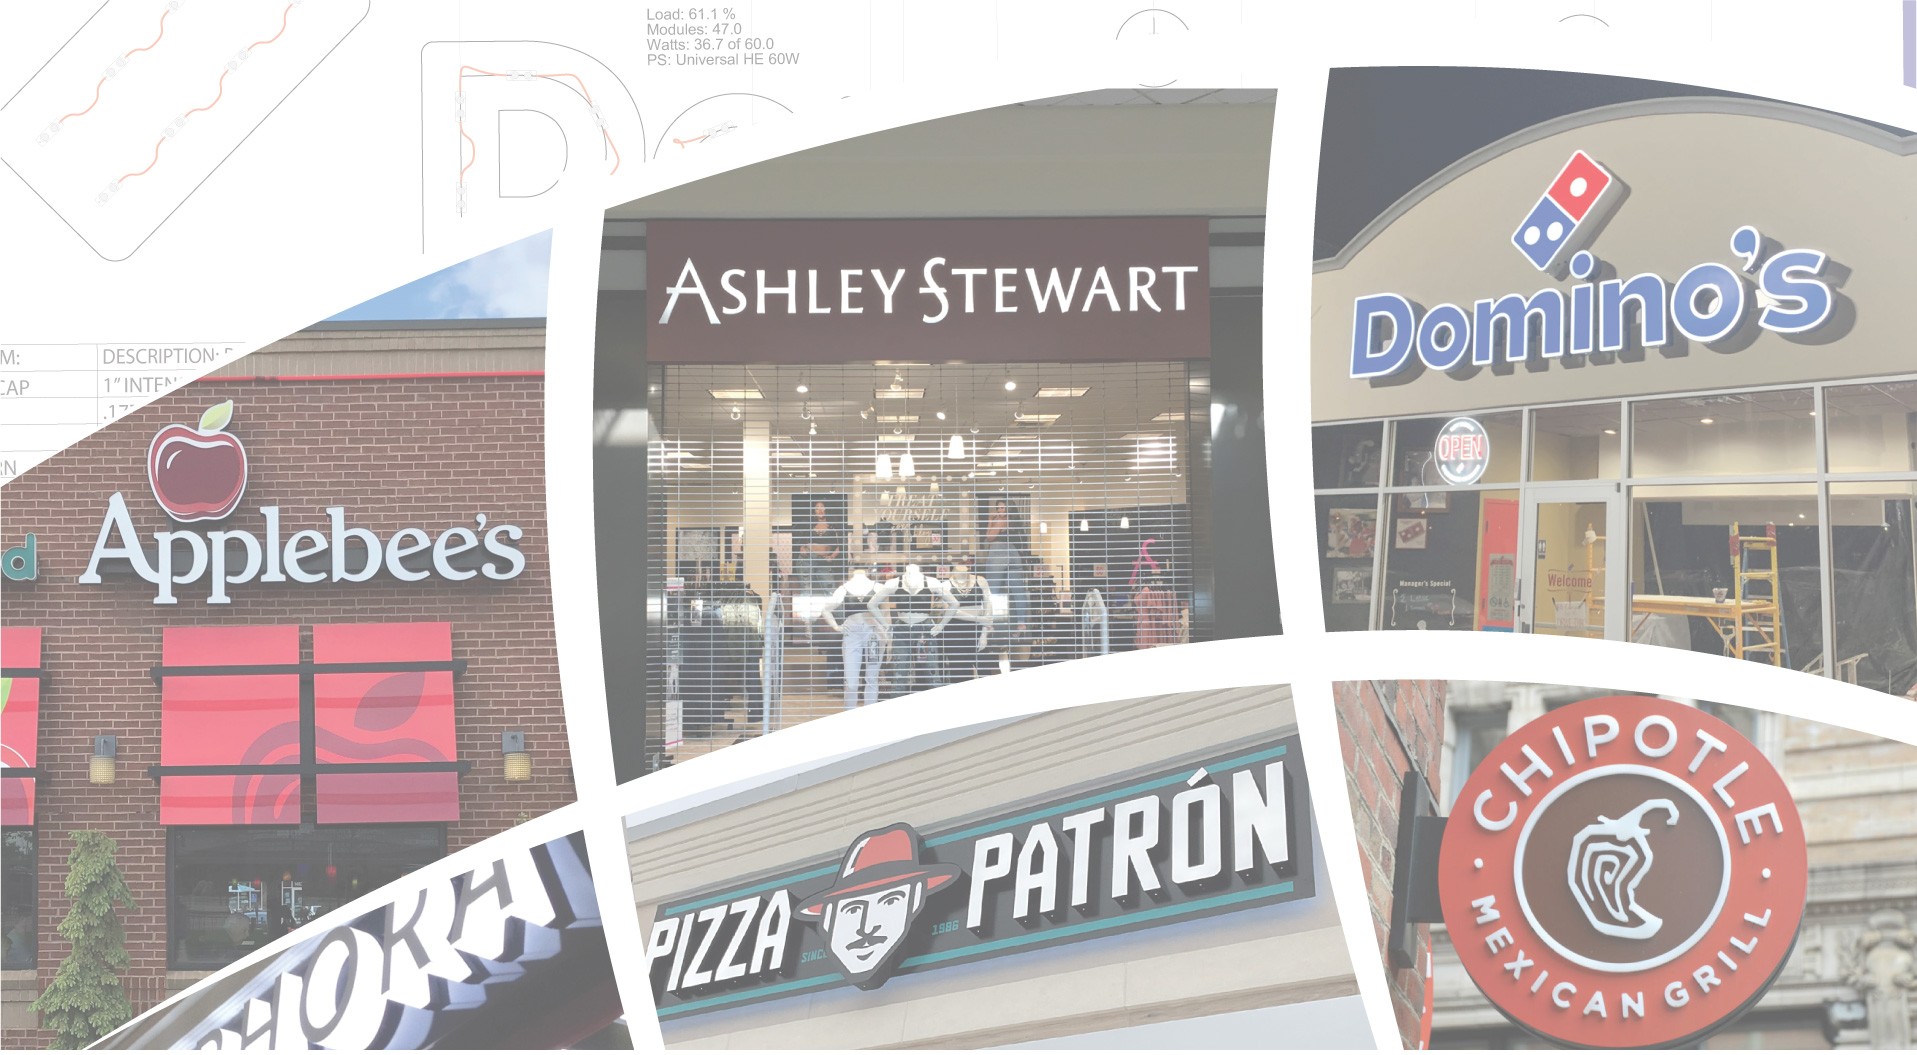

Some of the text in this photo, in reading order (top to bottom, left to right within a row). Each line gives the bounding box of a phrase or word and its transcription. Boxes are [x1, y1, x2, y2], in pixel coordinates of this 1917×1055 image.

[646, 8, 736, 21] Load: 61.1 %
[646, 23, 742, 35] Modules: 47.0
[646, 37, 775, 51] Watts: 36.7 of 60.0
[647, 53, 800, 66] PS: Universal HE 60W
[1350, 225, 1836, 379] Domino's
[1439, 433, 1483, 461] OPEN
[78, 491, 526, 604] Applebee's
[1399, 580, 1452, 588] Manager's Special
[1547, 573, 1592, 588] Welcome
[1473, 713, 1784, 845] CHIPOTLE
[645, 760, 1290, 992] PIZZA PATRÓN
[931, 919, 960, 936] 1986
[1471, 893, 1773, 1019] MEXICAN GRILL
